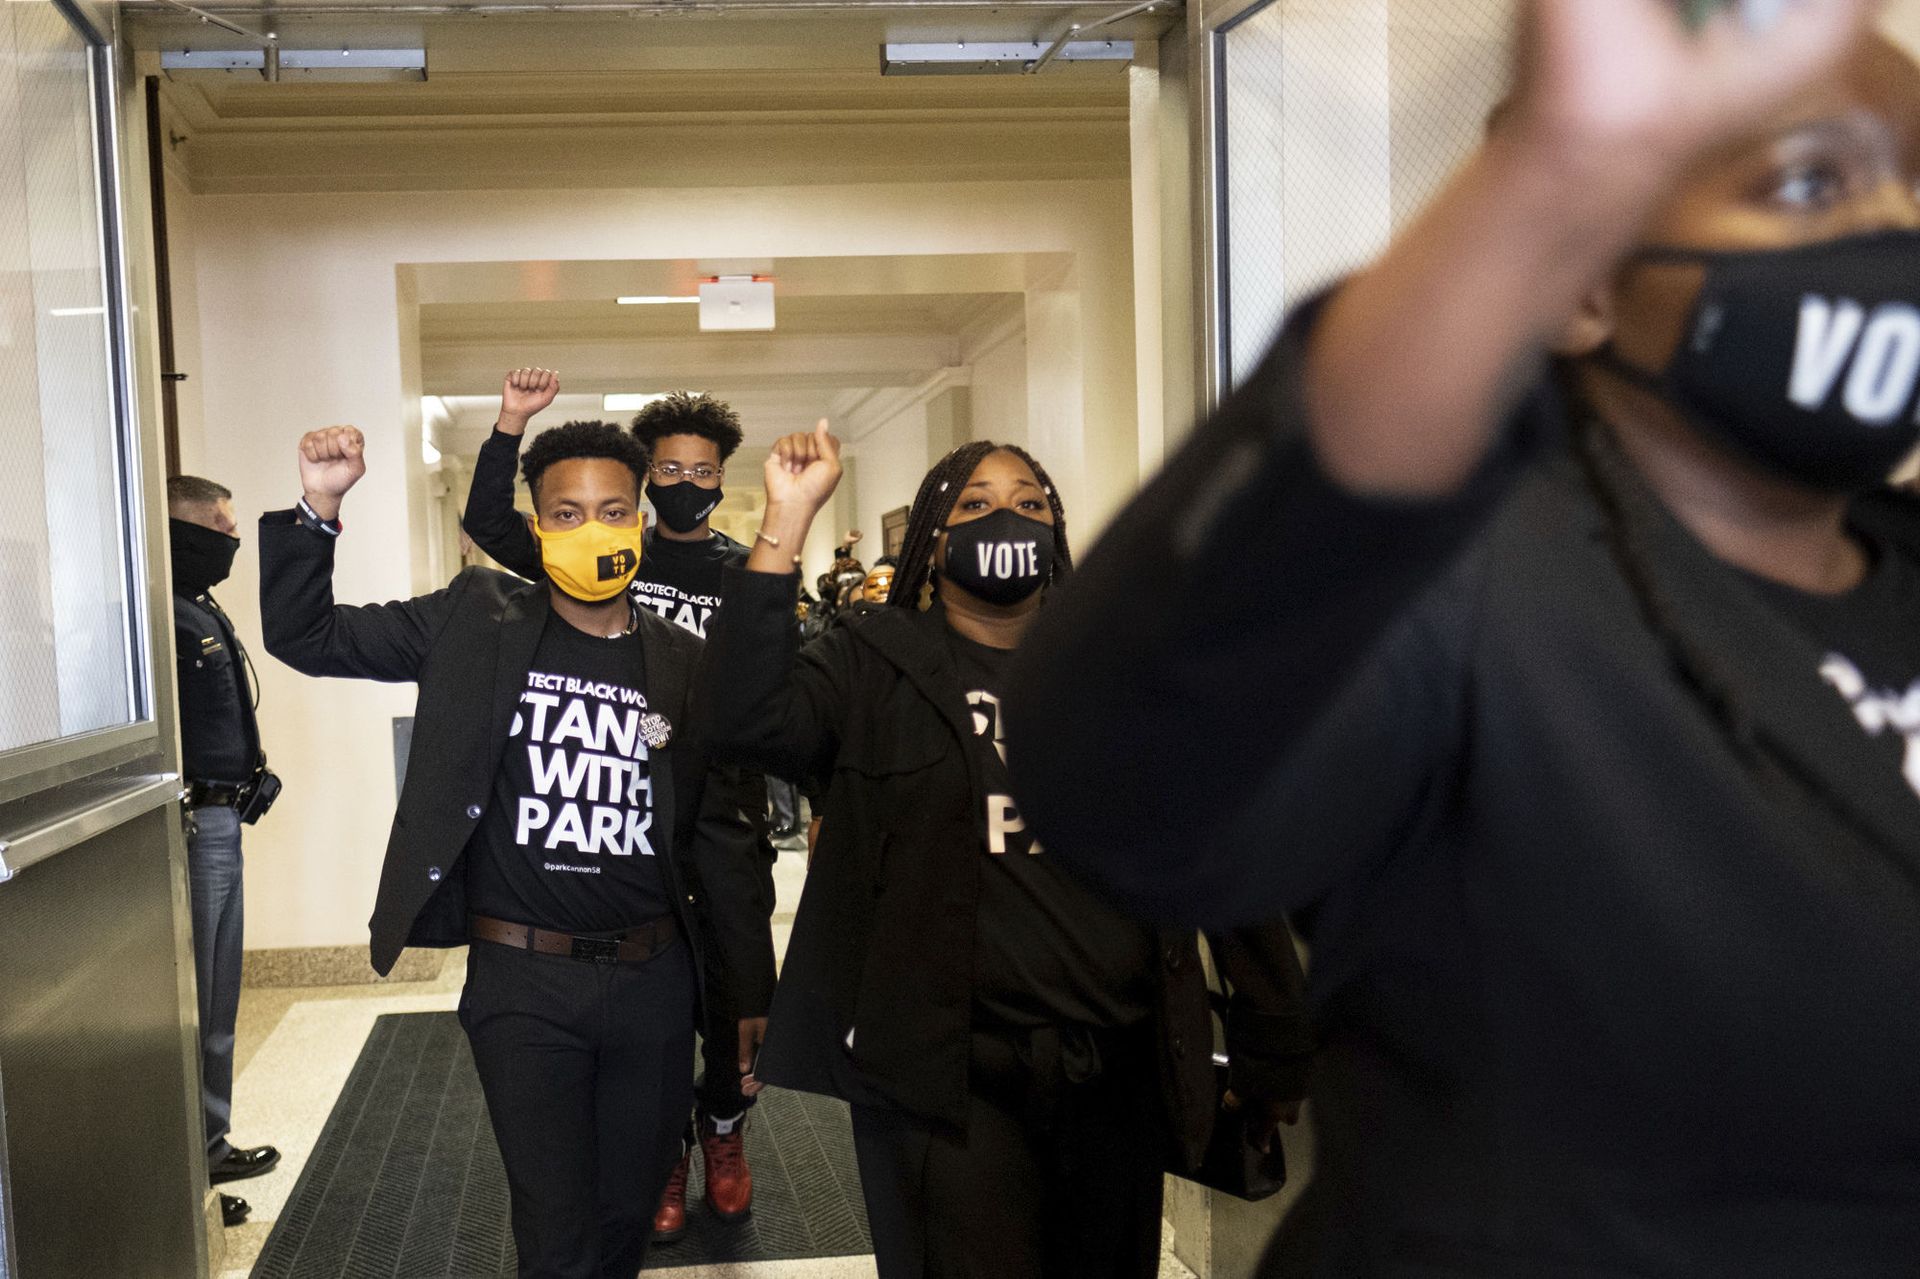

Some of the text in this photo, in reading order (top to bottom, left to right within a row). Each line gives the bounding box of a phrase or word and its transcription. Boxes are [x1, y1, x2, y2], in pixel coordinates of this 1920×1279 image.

[1786, 294, 1920, 427] VO
[977, 541, 1040, 580] VOTE
[630, 580, 678, 598] PROTECT
[678, 591, 714, 607] BLACK
[565, 677, 618, 703] BLACK
[620, 687, 648, 710] WO
[640, 714, 662, 730] STOP
[641, 721, 667, 735] VOTER
[648, 731, 670, 748] NOW!
[527, 745, 653, 808] WITH
[515, 796, 656, 857] PARK
[987, 794, 1044, 854] P
[544, 862, 601, 874] @parkcannon58
